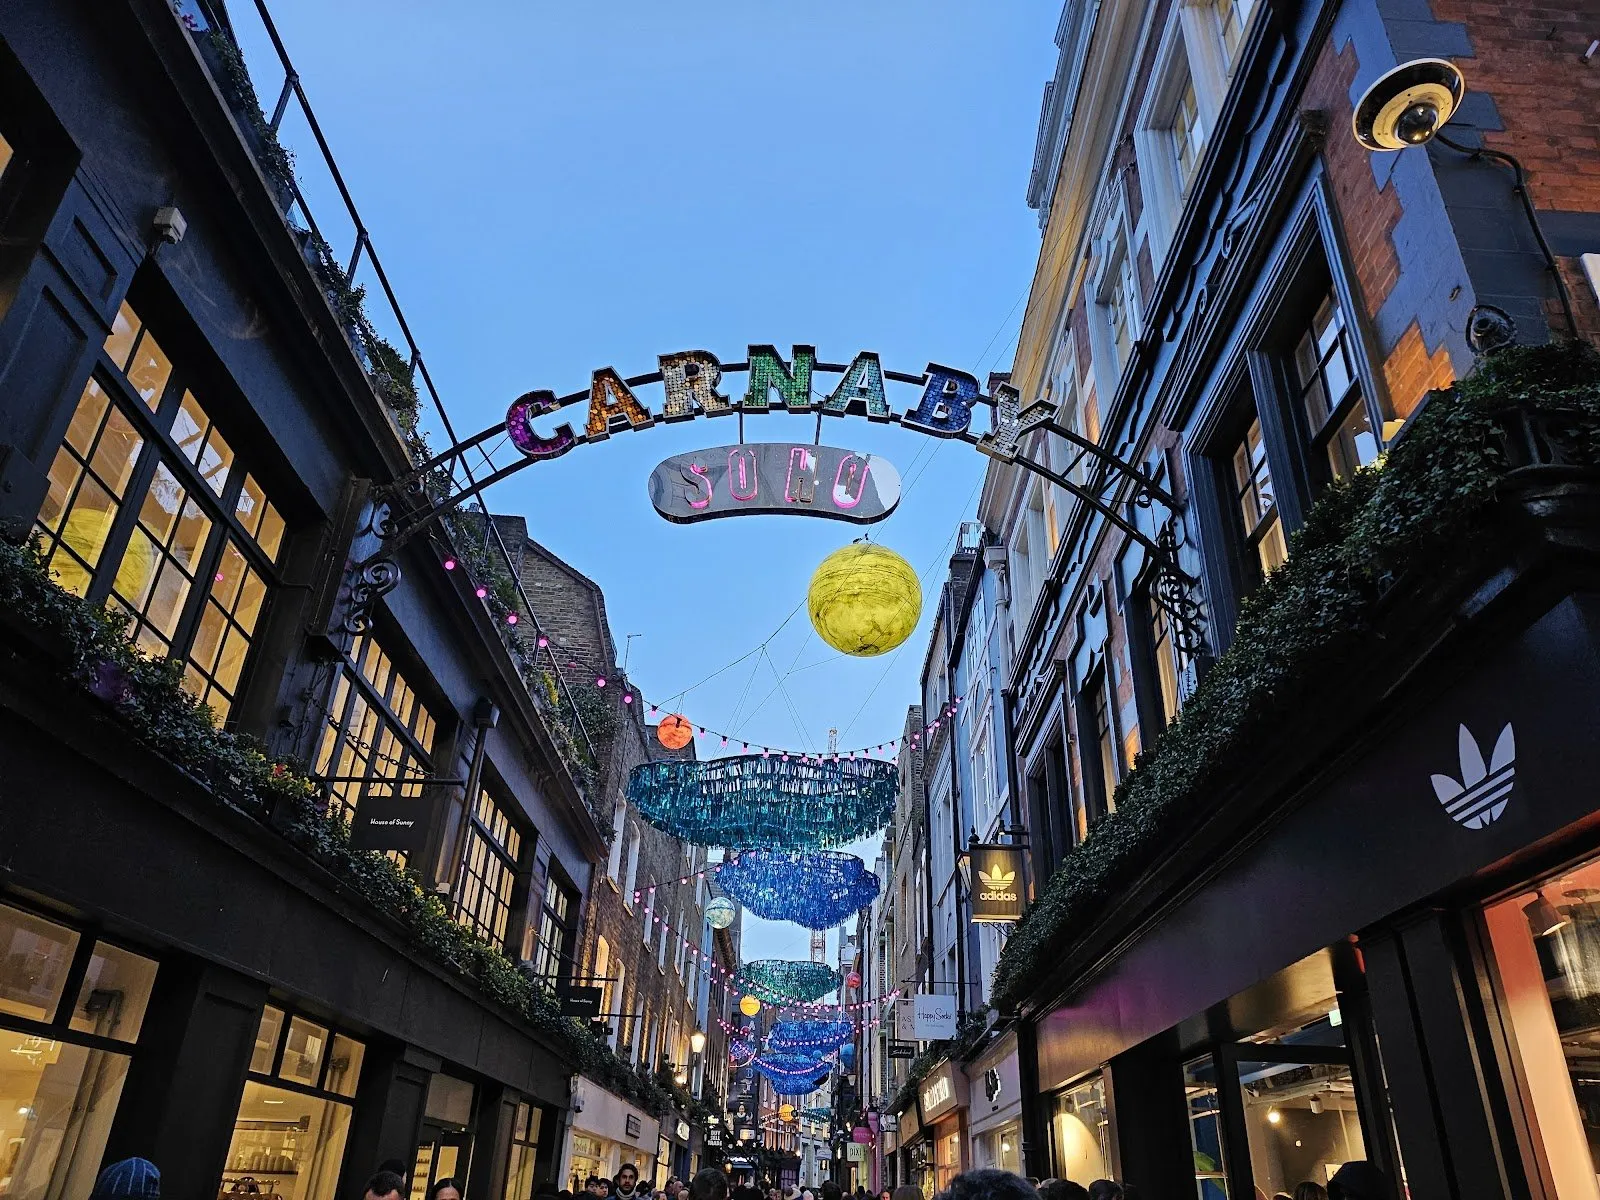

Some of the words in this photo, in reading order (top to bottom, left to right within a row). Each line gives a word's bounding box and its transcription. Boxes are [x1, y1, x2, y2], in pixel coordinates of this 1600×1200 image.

[505, 344, 1060, 464] CARNABY
[680, 447, 870, 509] SOHO
[980, 890, 1017, 901] adidas
